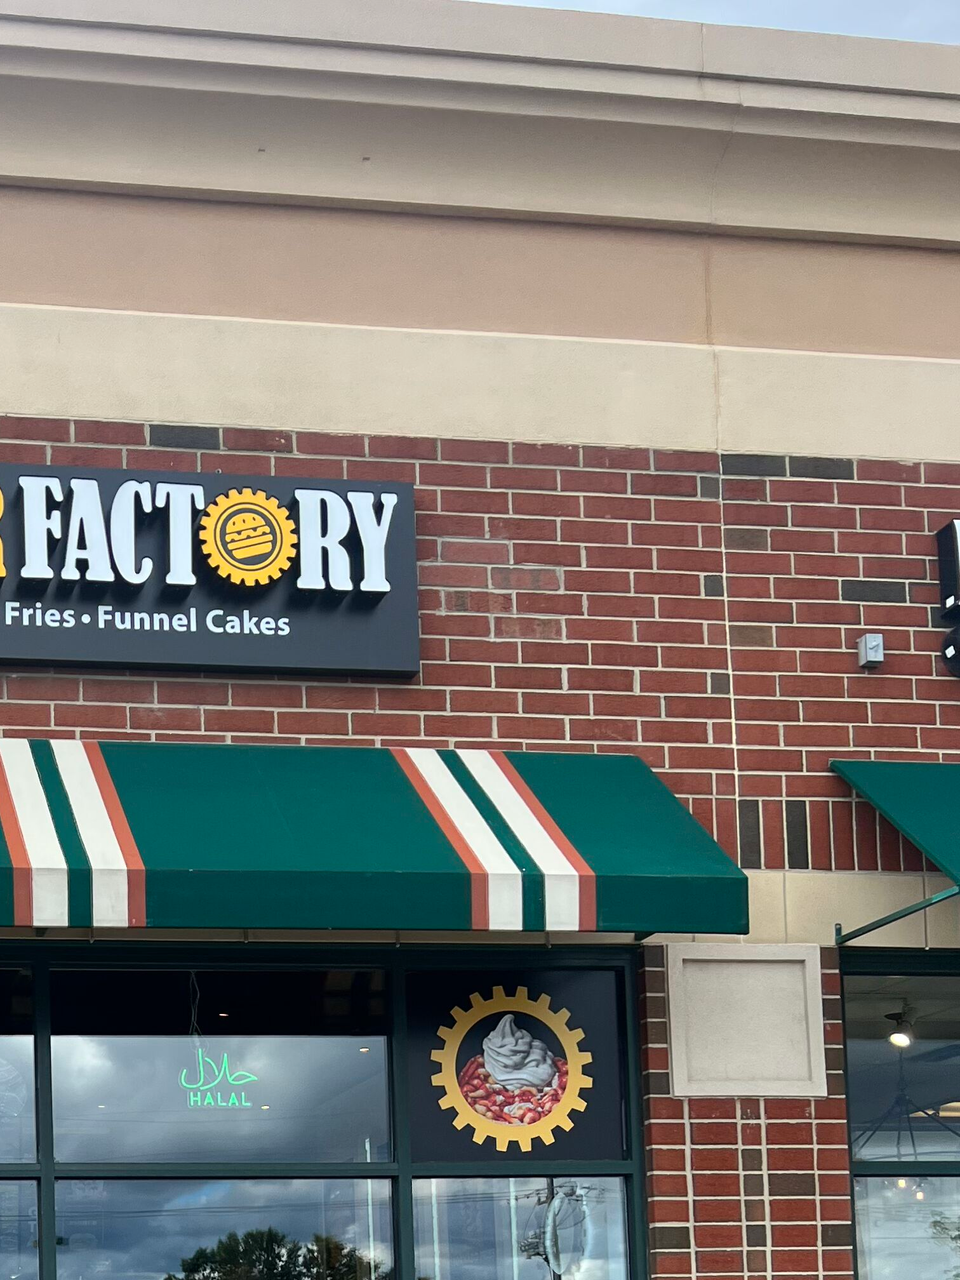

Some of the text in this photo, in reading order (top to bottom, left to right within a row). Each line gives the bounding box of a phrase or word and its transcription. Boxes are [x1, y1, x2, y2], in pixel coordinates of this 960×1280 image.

[5, 602, 76, 628] Fries
[98, 605, 197, 632] Funnel
[206, 609, 291, 636] Cakes
[189, 1091, 251, 1107] HALAL
